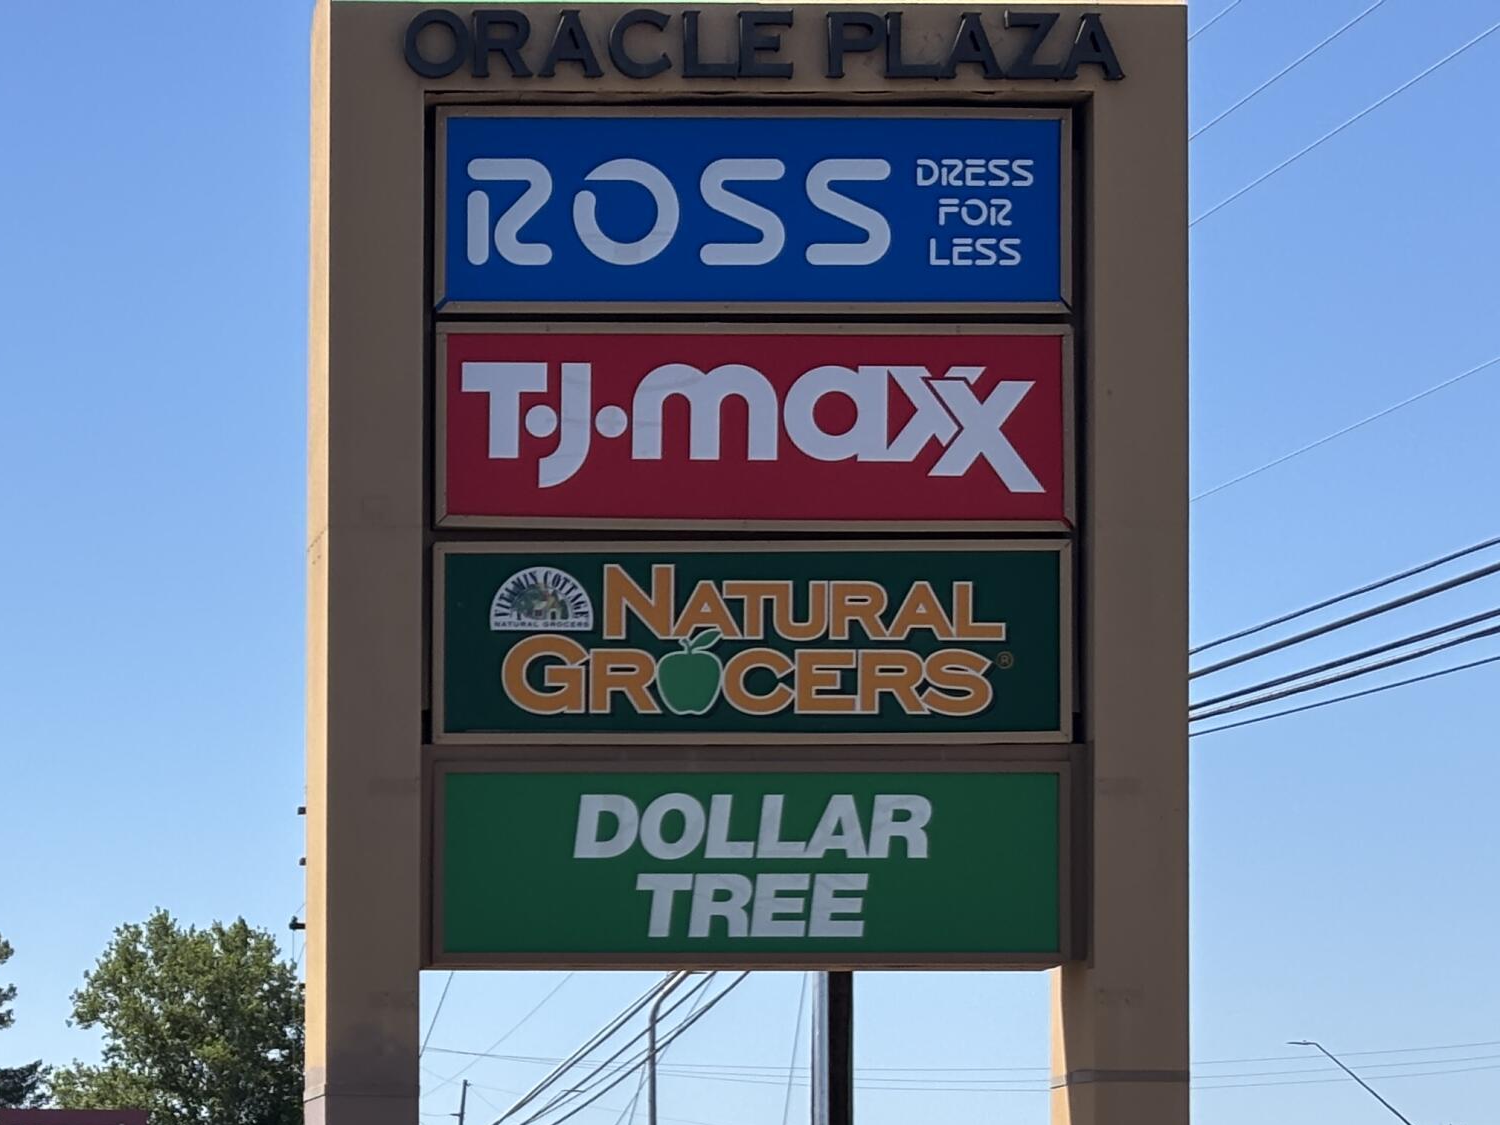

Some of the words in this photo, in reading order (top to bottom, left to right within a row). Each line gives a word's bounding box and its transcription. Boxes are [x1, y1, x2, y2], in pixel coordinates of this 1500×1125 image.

[402, 9, 794, 79] ORACLE
[825, 10, 1126, 81] PLAZA
[916, 158, 1035, 188] DRESS
[466, 158, 891, 266] ROSS
[938, 198, 1013, 227] FOR
[929, 238, 1022, 267] LESS
[603, 563, 1006, 640] NATURAL
[573, 793, 933, 860] DOLLAR
[636, 873, 869, 938] TREE
